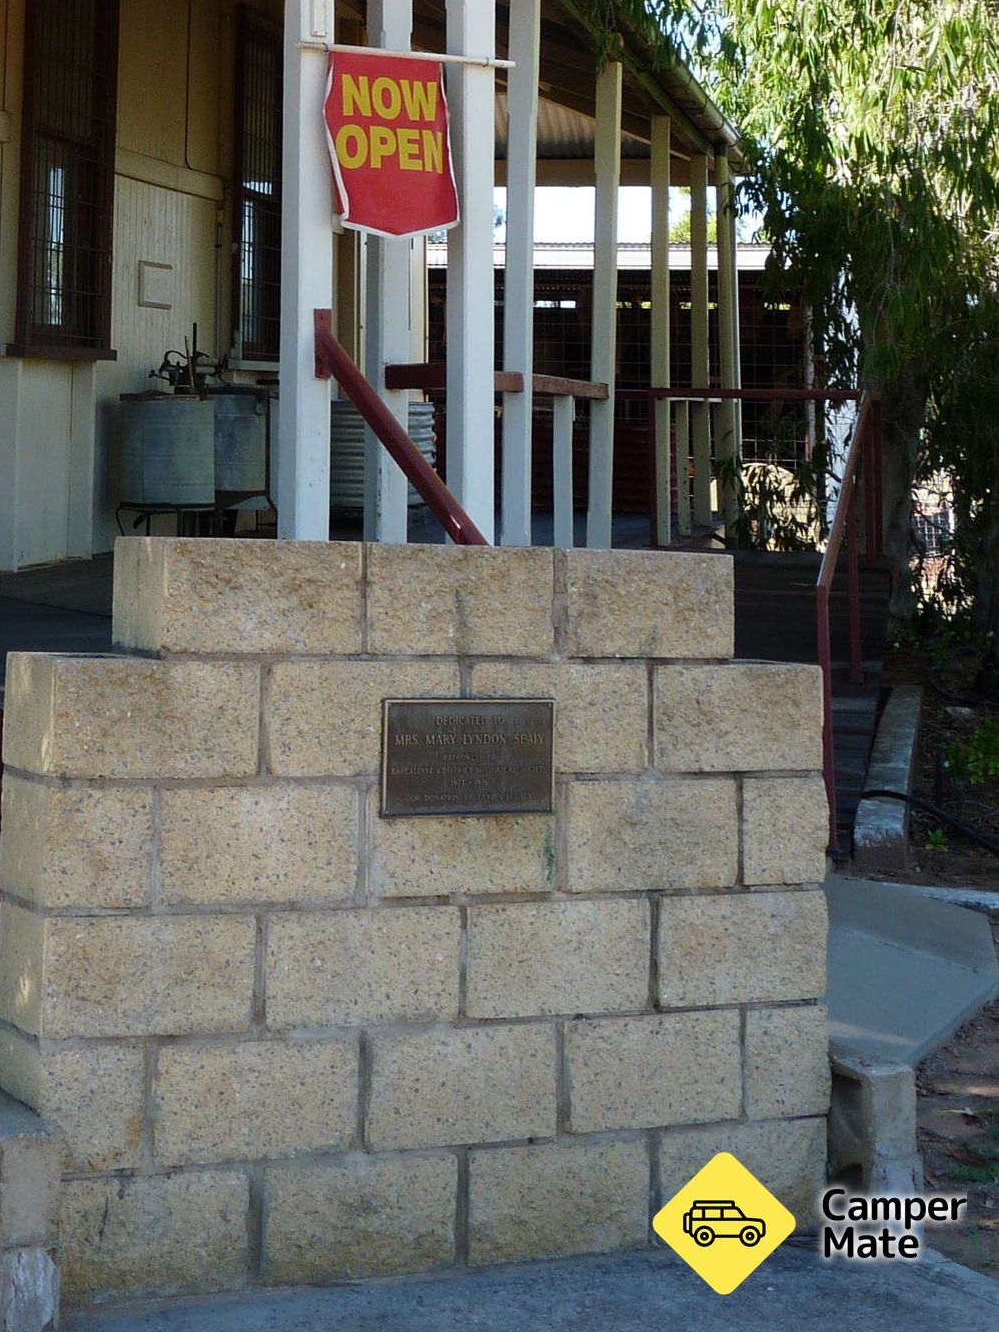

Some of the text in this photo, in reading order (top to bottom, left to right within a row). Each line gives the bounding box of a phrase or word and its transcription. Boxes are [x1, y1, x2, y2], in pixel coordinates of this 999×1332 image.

[341, 73, 438, 122] NOW
[335, 123, 444, 175] OPEN
[436, 715, 506, 725] DEDICATED TO
[425, 733, 457, 746] MARY
[463, 733, 508, 745] LYNDON
